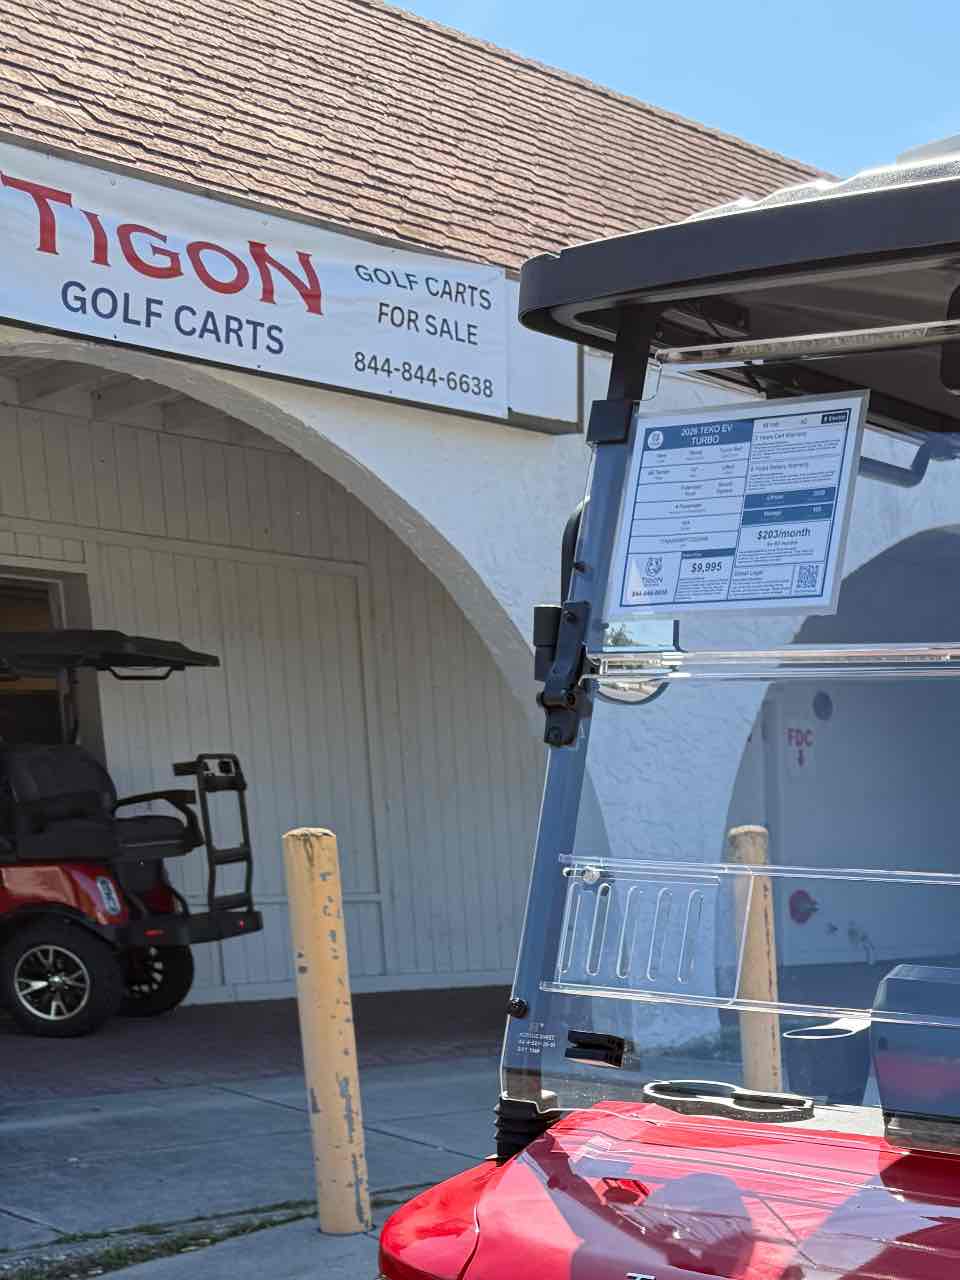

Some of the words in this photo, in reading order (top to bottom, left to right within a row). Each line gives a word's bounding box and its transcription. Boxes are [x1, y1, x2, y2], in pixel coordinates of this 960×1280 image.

[0, 170, 324, 316] TIGON
[354, 264, 419, 292] GOLF
[425, 276, 493, 310] CARTS
[61, 280, 165, 329] GOLF
[174, 304, 284, 355] CARTS
[377, 302, 420, 333] FOR
[425, 313, 479, 346] SALE
[354, 351, 494, 399] 844-844-6638
[691, 434, 720, 446] TURBO
[690, 561, 722, 574] $9,995
